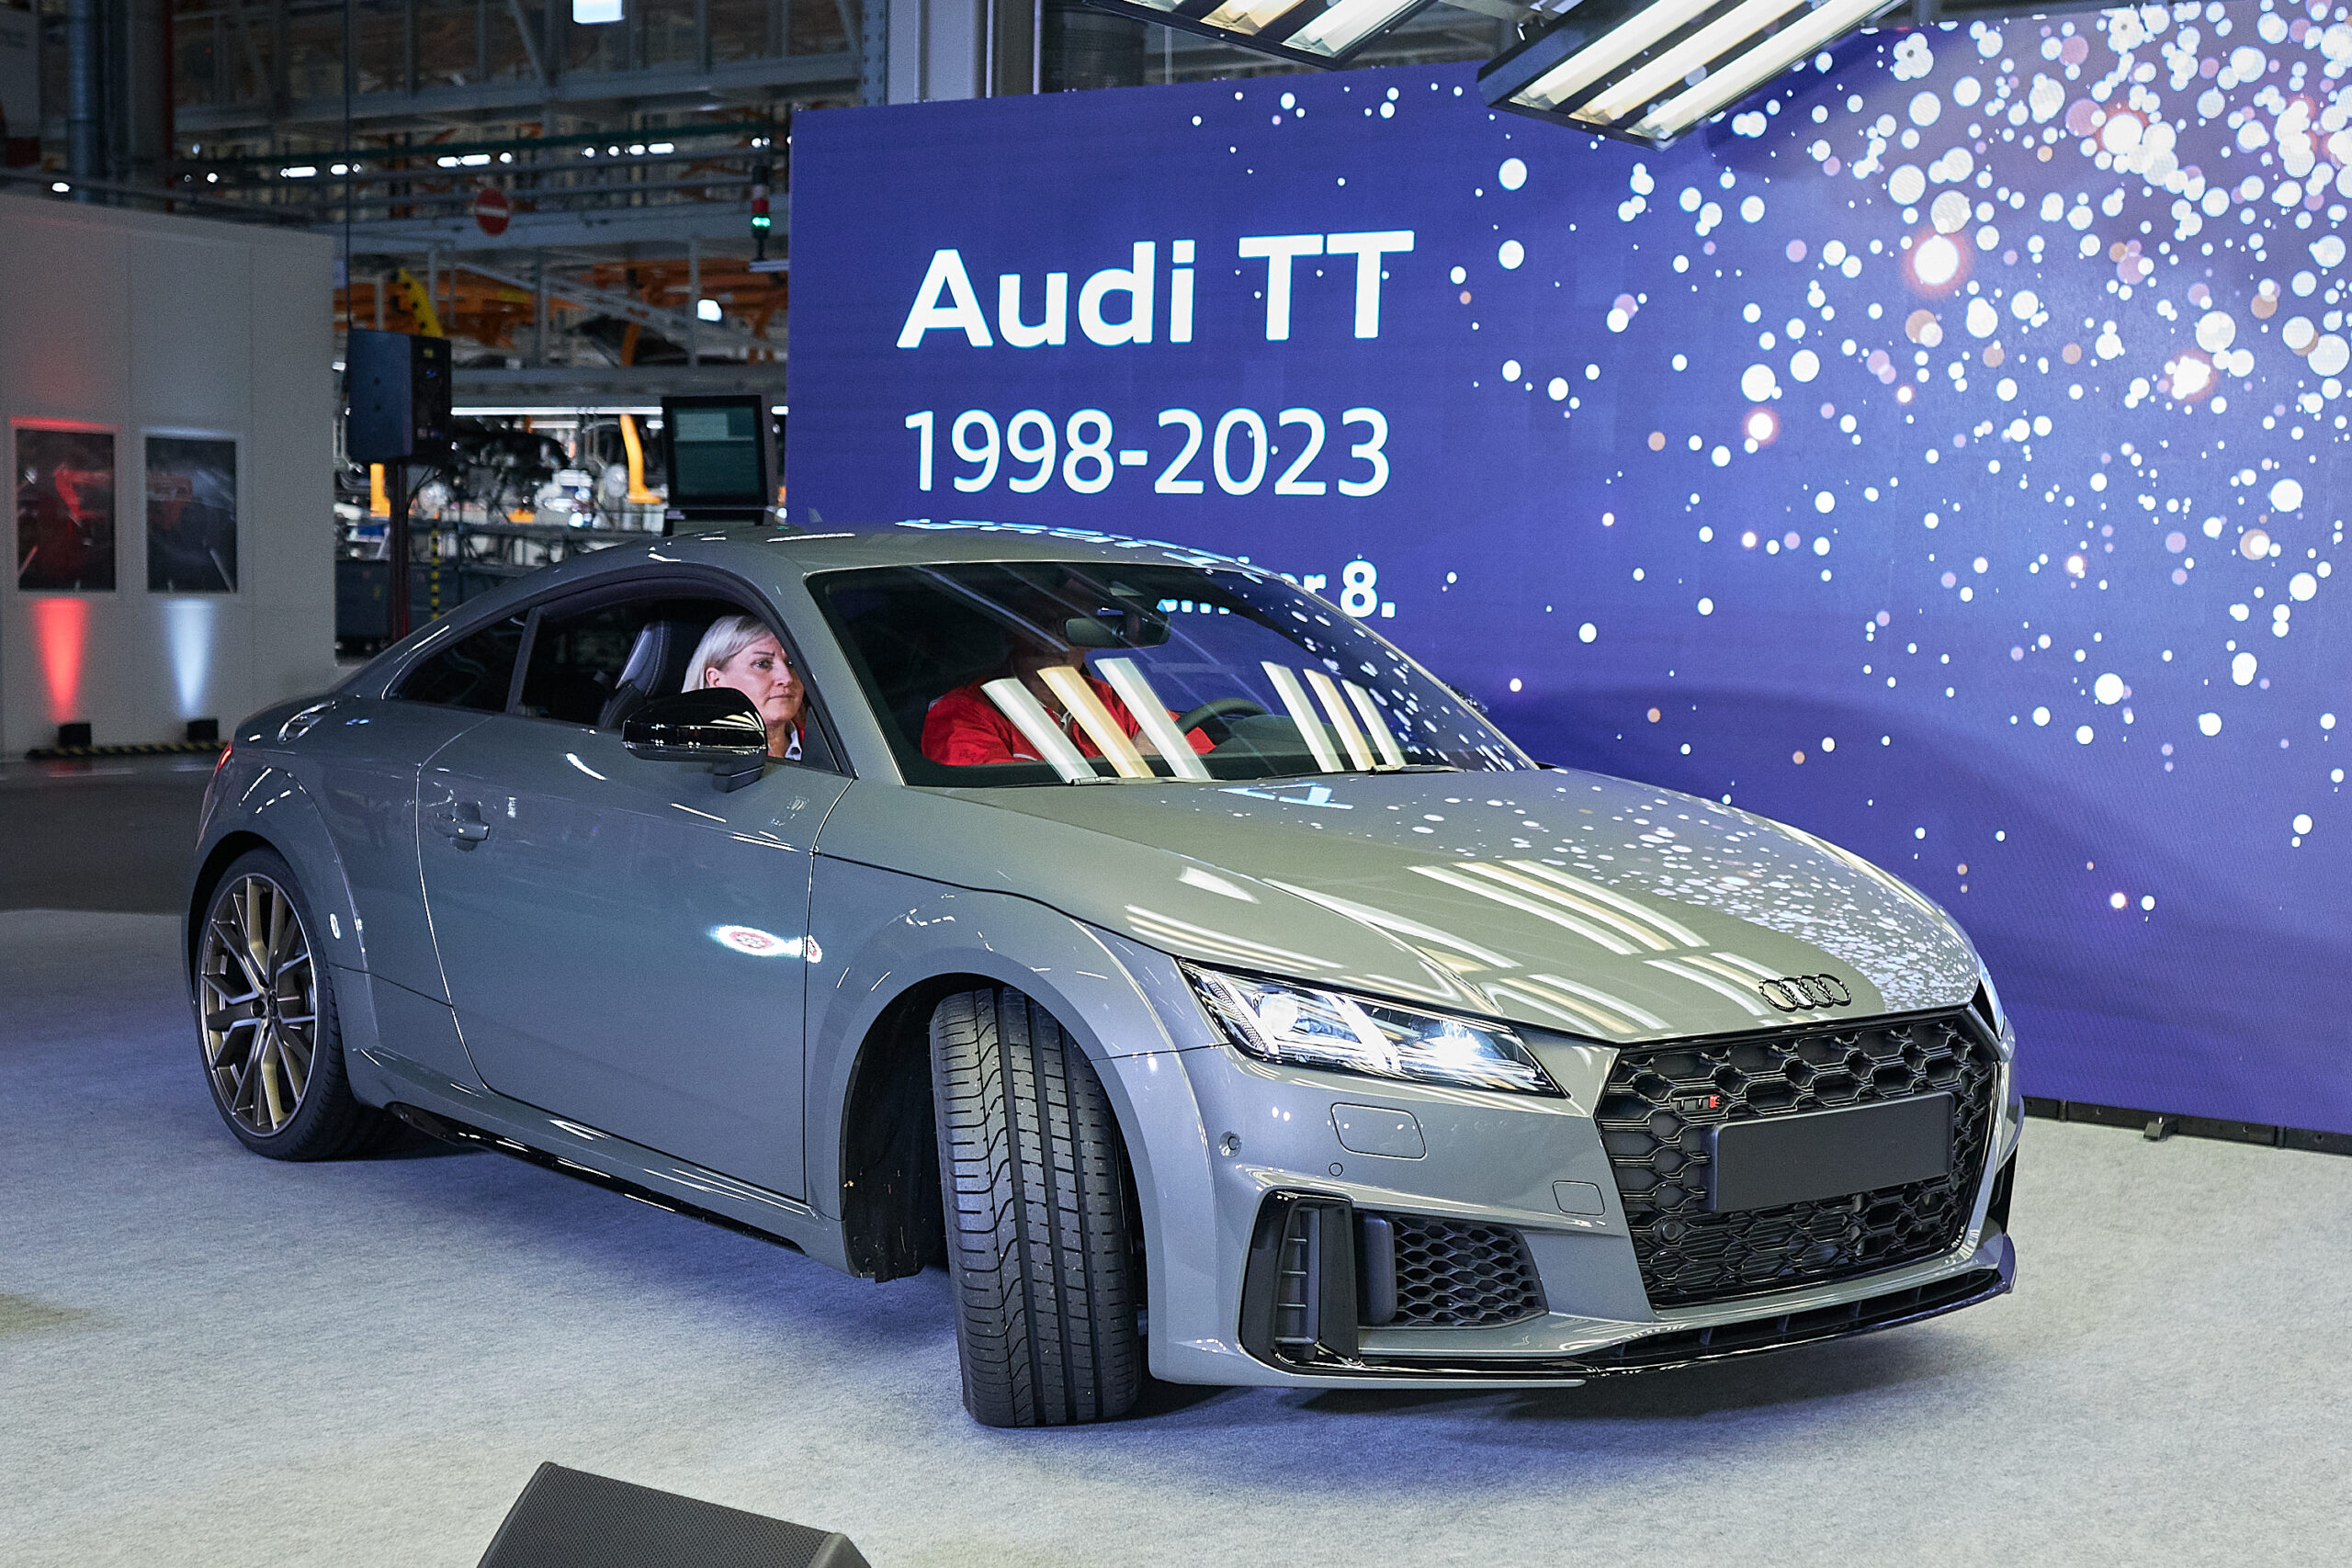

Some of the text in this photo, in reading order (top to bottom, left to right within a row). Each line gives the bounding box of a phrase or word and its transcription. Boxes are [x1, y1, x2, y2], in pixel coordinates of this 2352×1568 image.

[896, 230, 1415, 349] Audi TT
[904, 407, 1389, 497] 1998-2023
[1340, 559, 1396, 618] 8.
